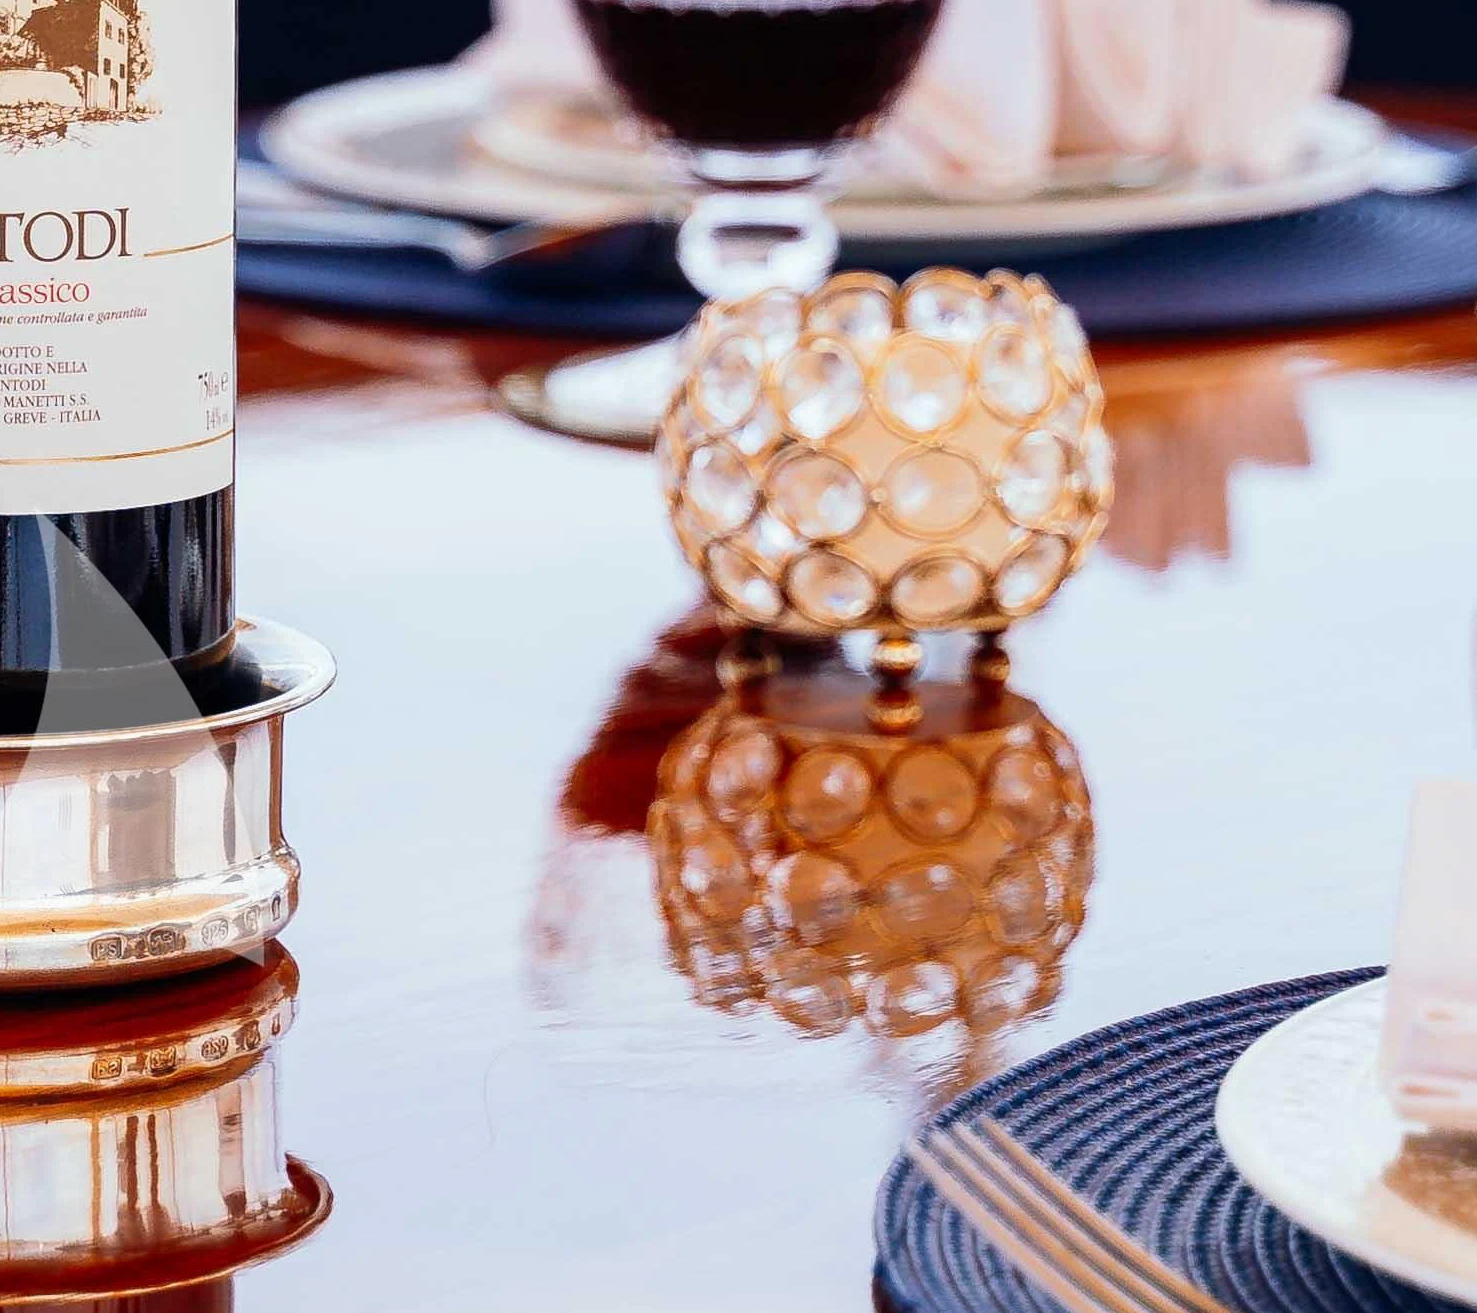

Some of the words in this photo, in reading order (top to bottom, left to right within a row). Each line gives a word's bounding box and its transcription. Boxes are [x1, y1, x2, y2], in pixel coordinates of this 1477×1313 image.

[17, 311, 84, 324] controllata
[88, 313, 94, 322] e
[97, 306, 148, 325] garantita
[45, 345, 54, 358] E
[46, 361, 88, 374] NELLA
[3, 394, 65, 407] MANETTI
[3, 412, 47, 424] GREVE
[59, 409, 101, 423] ITALIA
